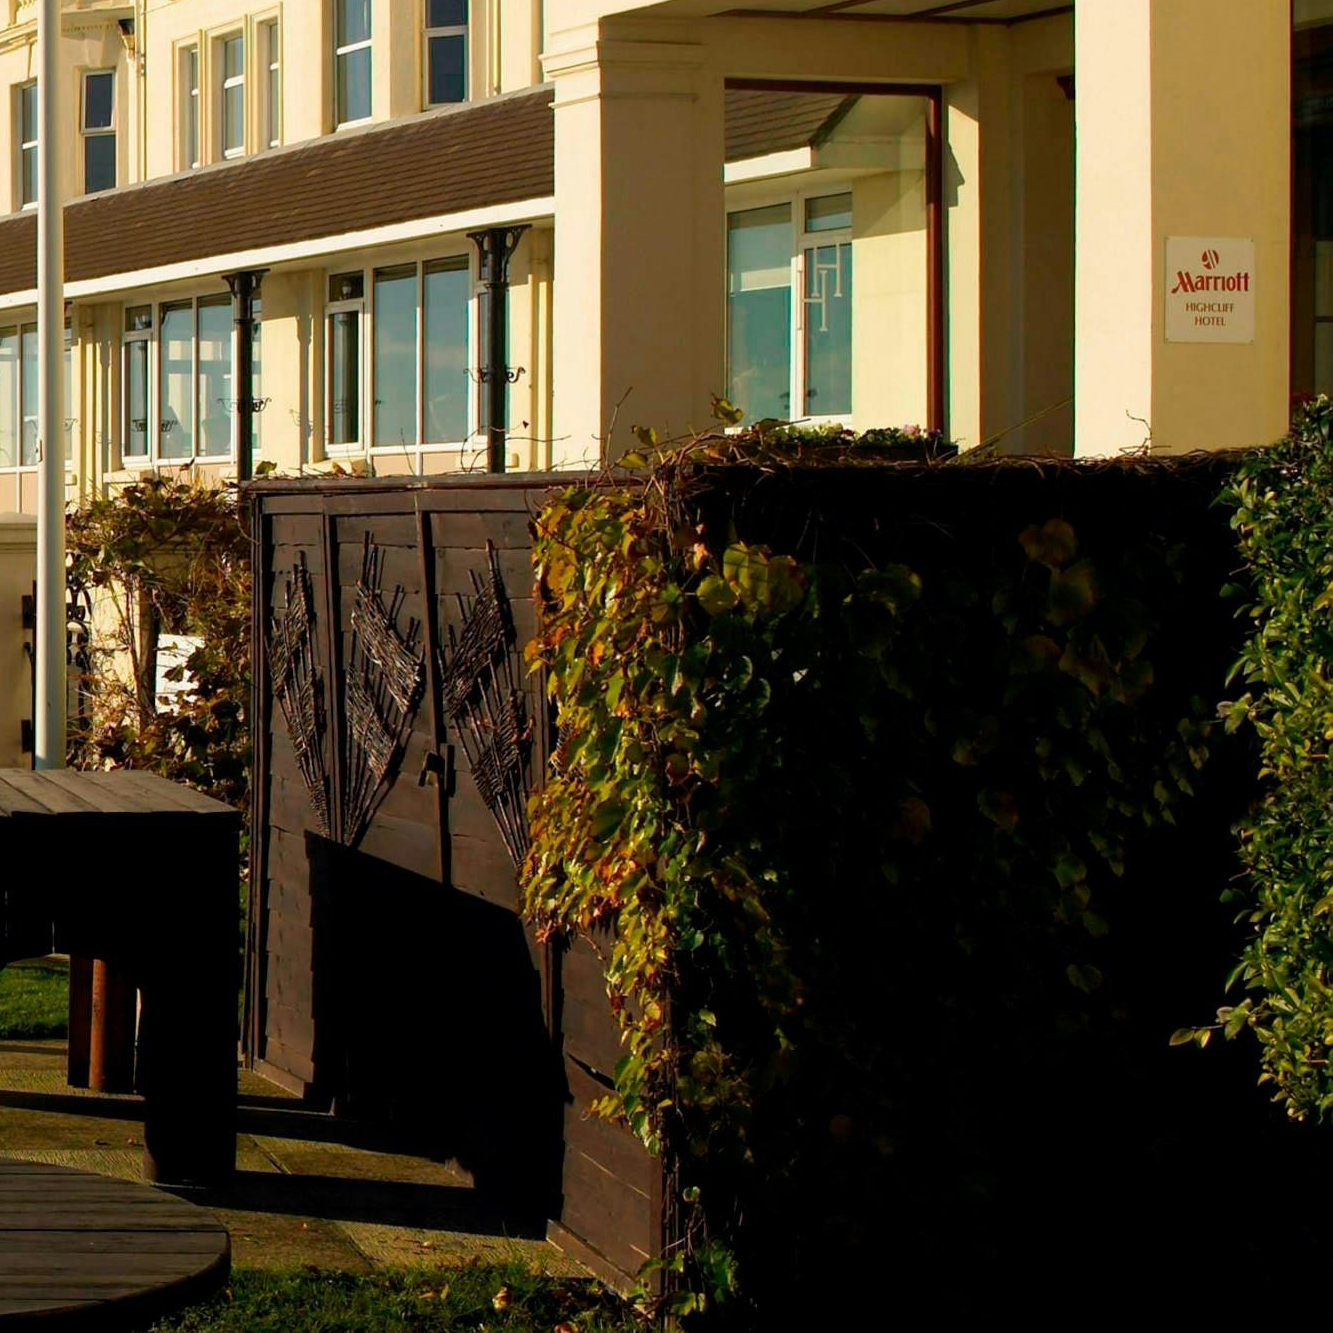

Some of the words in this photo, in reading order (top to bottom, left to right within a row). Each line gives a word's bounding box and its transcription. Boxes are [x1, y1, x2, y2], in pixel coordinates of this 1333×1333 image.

[1171, 270, 1249, 294] Marriott
[1185, 302, 1235, 313] HIGHCLIFF
[1194, 316, 1226, 327] HOTEL
